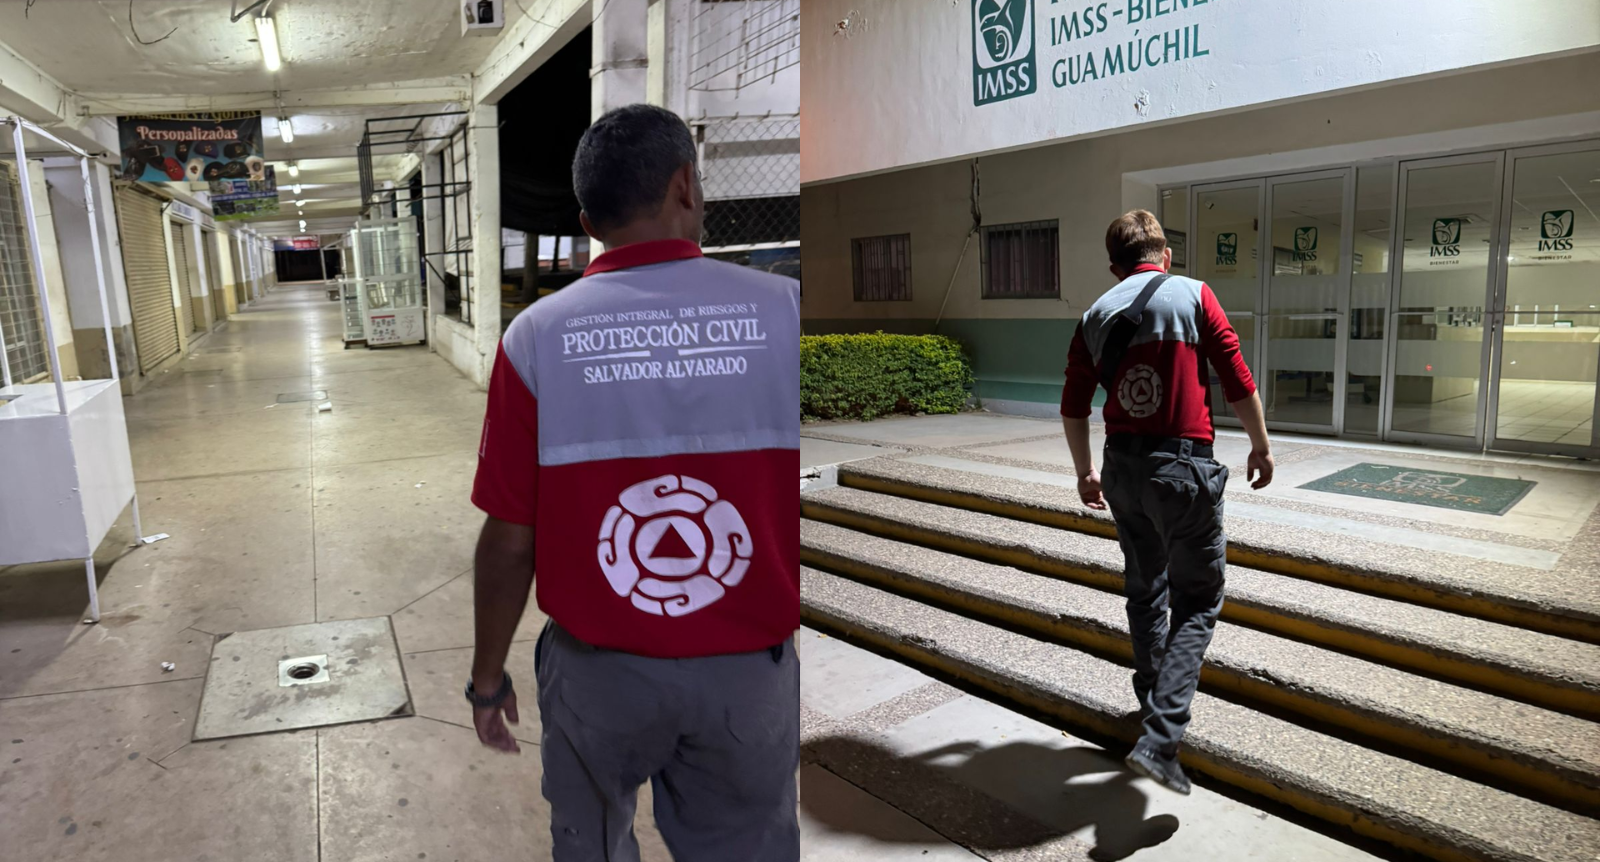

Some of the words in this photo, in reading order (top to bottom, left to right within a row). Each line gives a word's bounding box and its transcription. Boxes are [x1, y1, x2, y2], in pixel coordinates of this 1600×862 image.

[1052, 23, 1210, 89] GUAMÚCHIL
[977, 61, 1031, 101] IMSS
[136, 126, 239, 141] Personalizadas
[1430, 245, 1461, 257] IMSS
[1538, 238, 1574, 252] IMSS
[1216, 255, 1238, 266] IMSS
[1292, 251, 1317, 262] IMSS
[565, 313, 614, 329] GESTIÓN
[617, 308, 674, 322] INTEGRAL
[679, 306, 696, 319] DE
[698, 303, 749, 317] RIESGOS
[749, 302, 759, 314] Y
[561, 321, 701, 355] PROTECCIÓN
[705, 318, 767, 343] CIVIL
[583, 361, 663, 385] SALVADOR
[664, 355, 748, 379] ALVARADO
